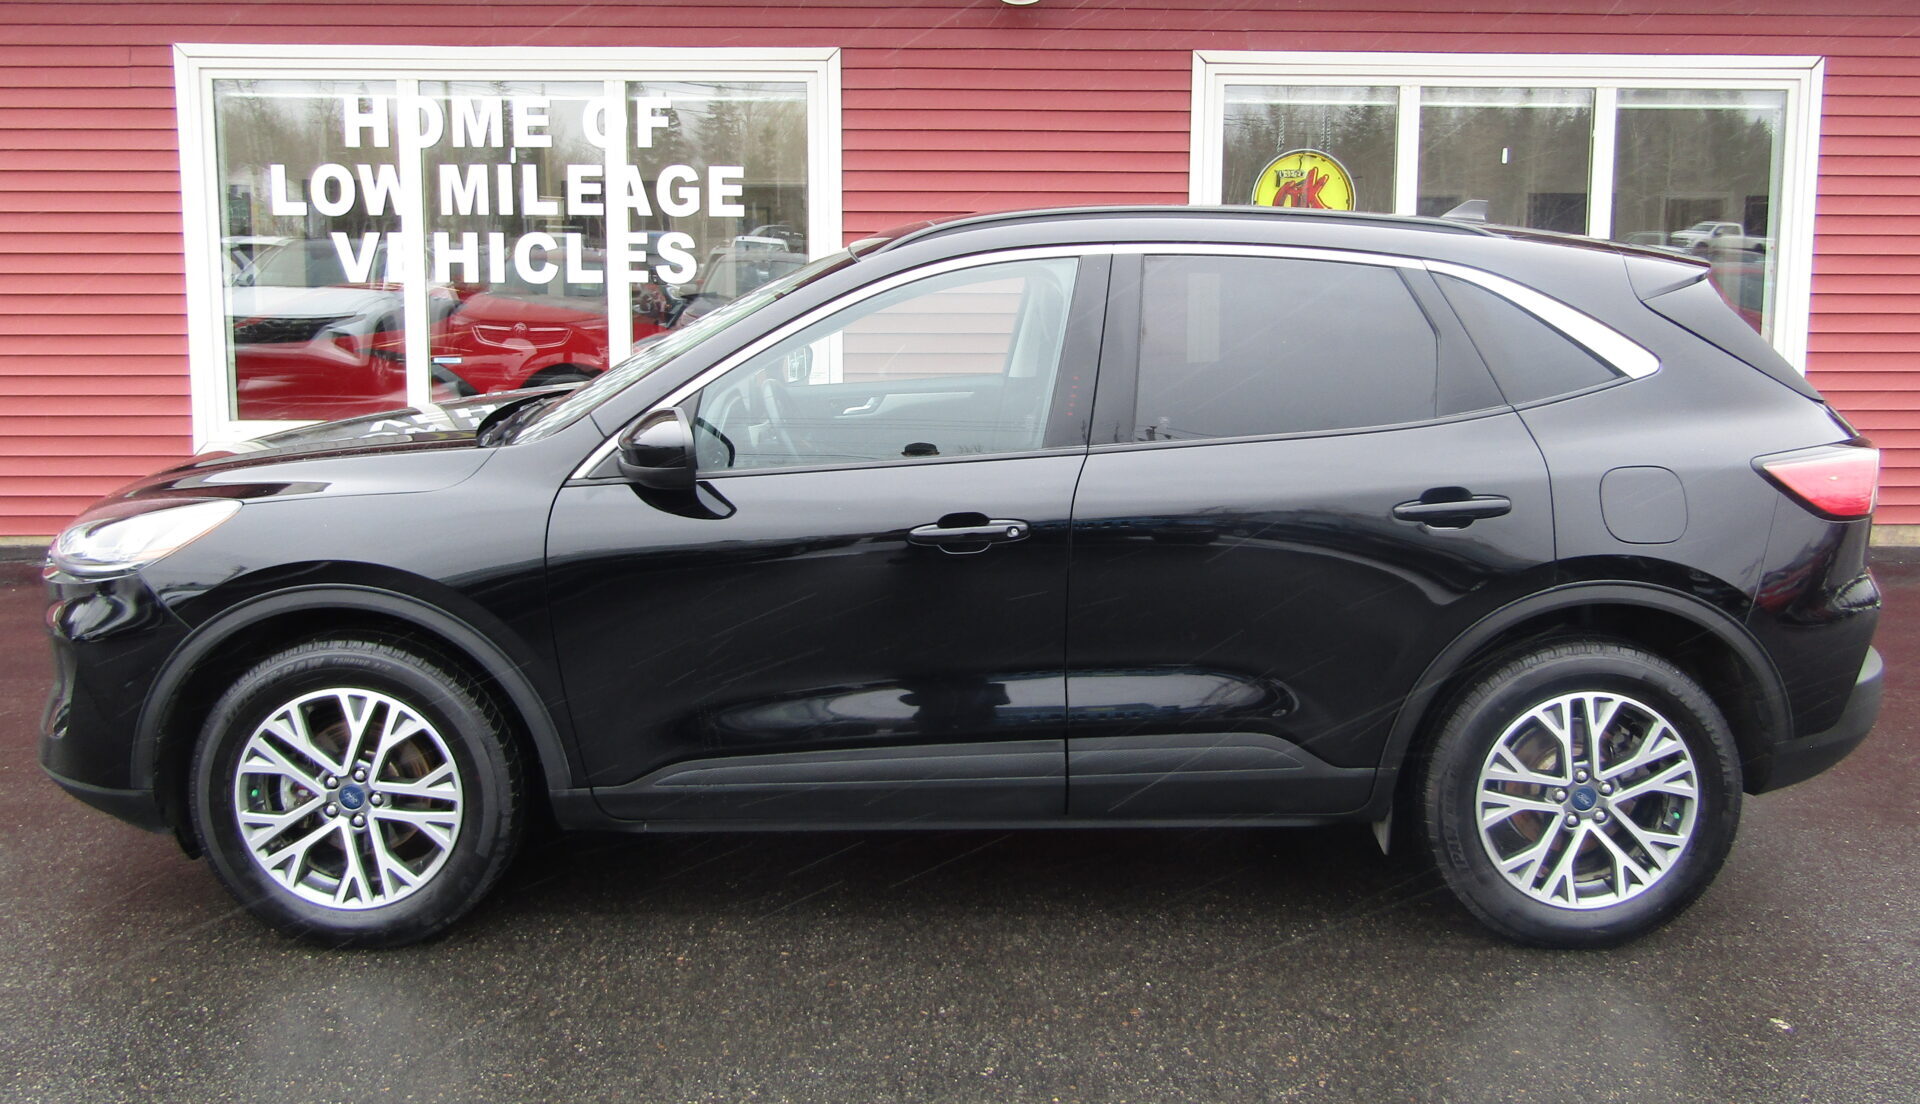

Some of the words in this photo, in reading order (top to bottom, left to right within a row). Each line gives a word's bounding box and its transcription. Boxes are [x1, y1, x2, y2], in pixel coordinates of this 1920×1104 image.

[344, 97, 553, 148] HOME
[271, 164, 402, 216] LOW
[439, 164, 745, 217] MILEAGE
